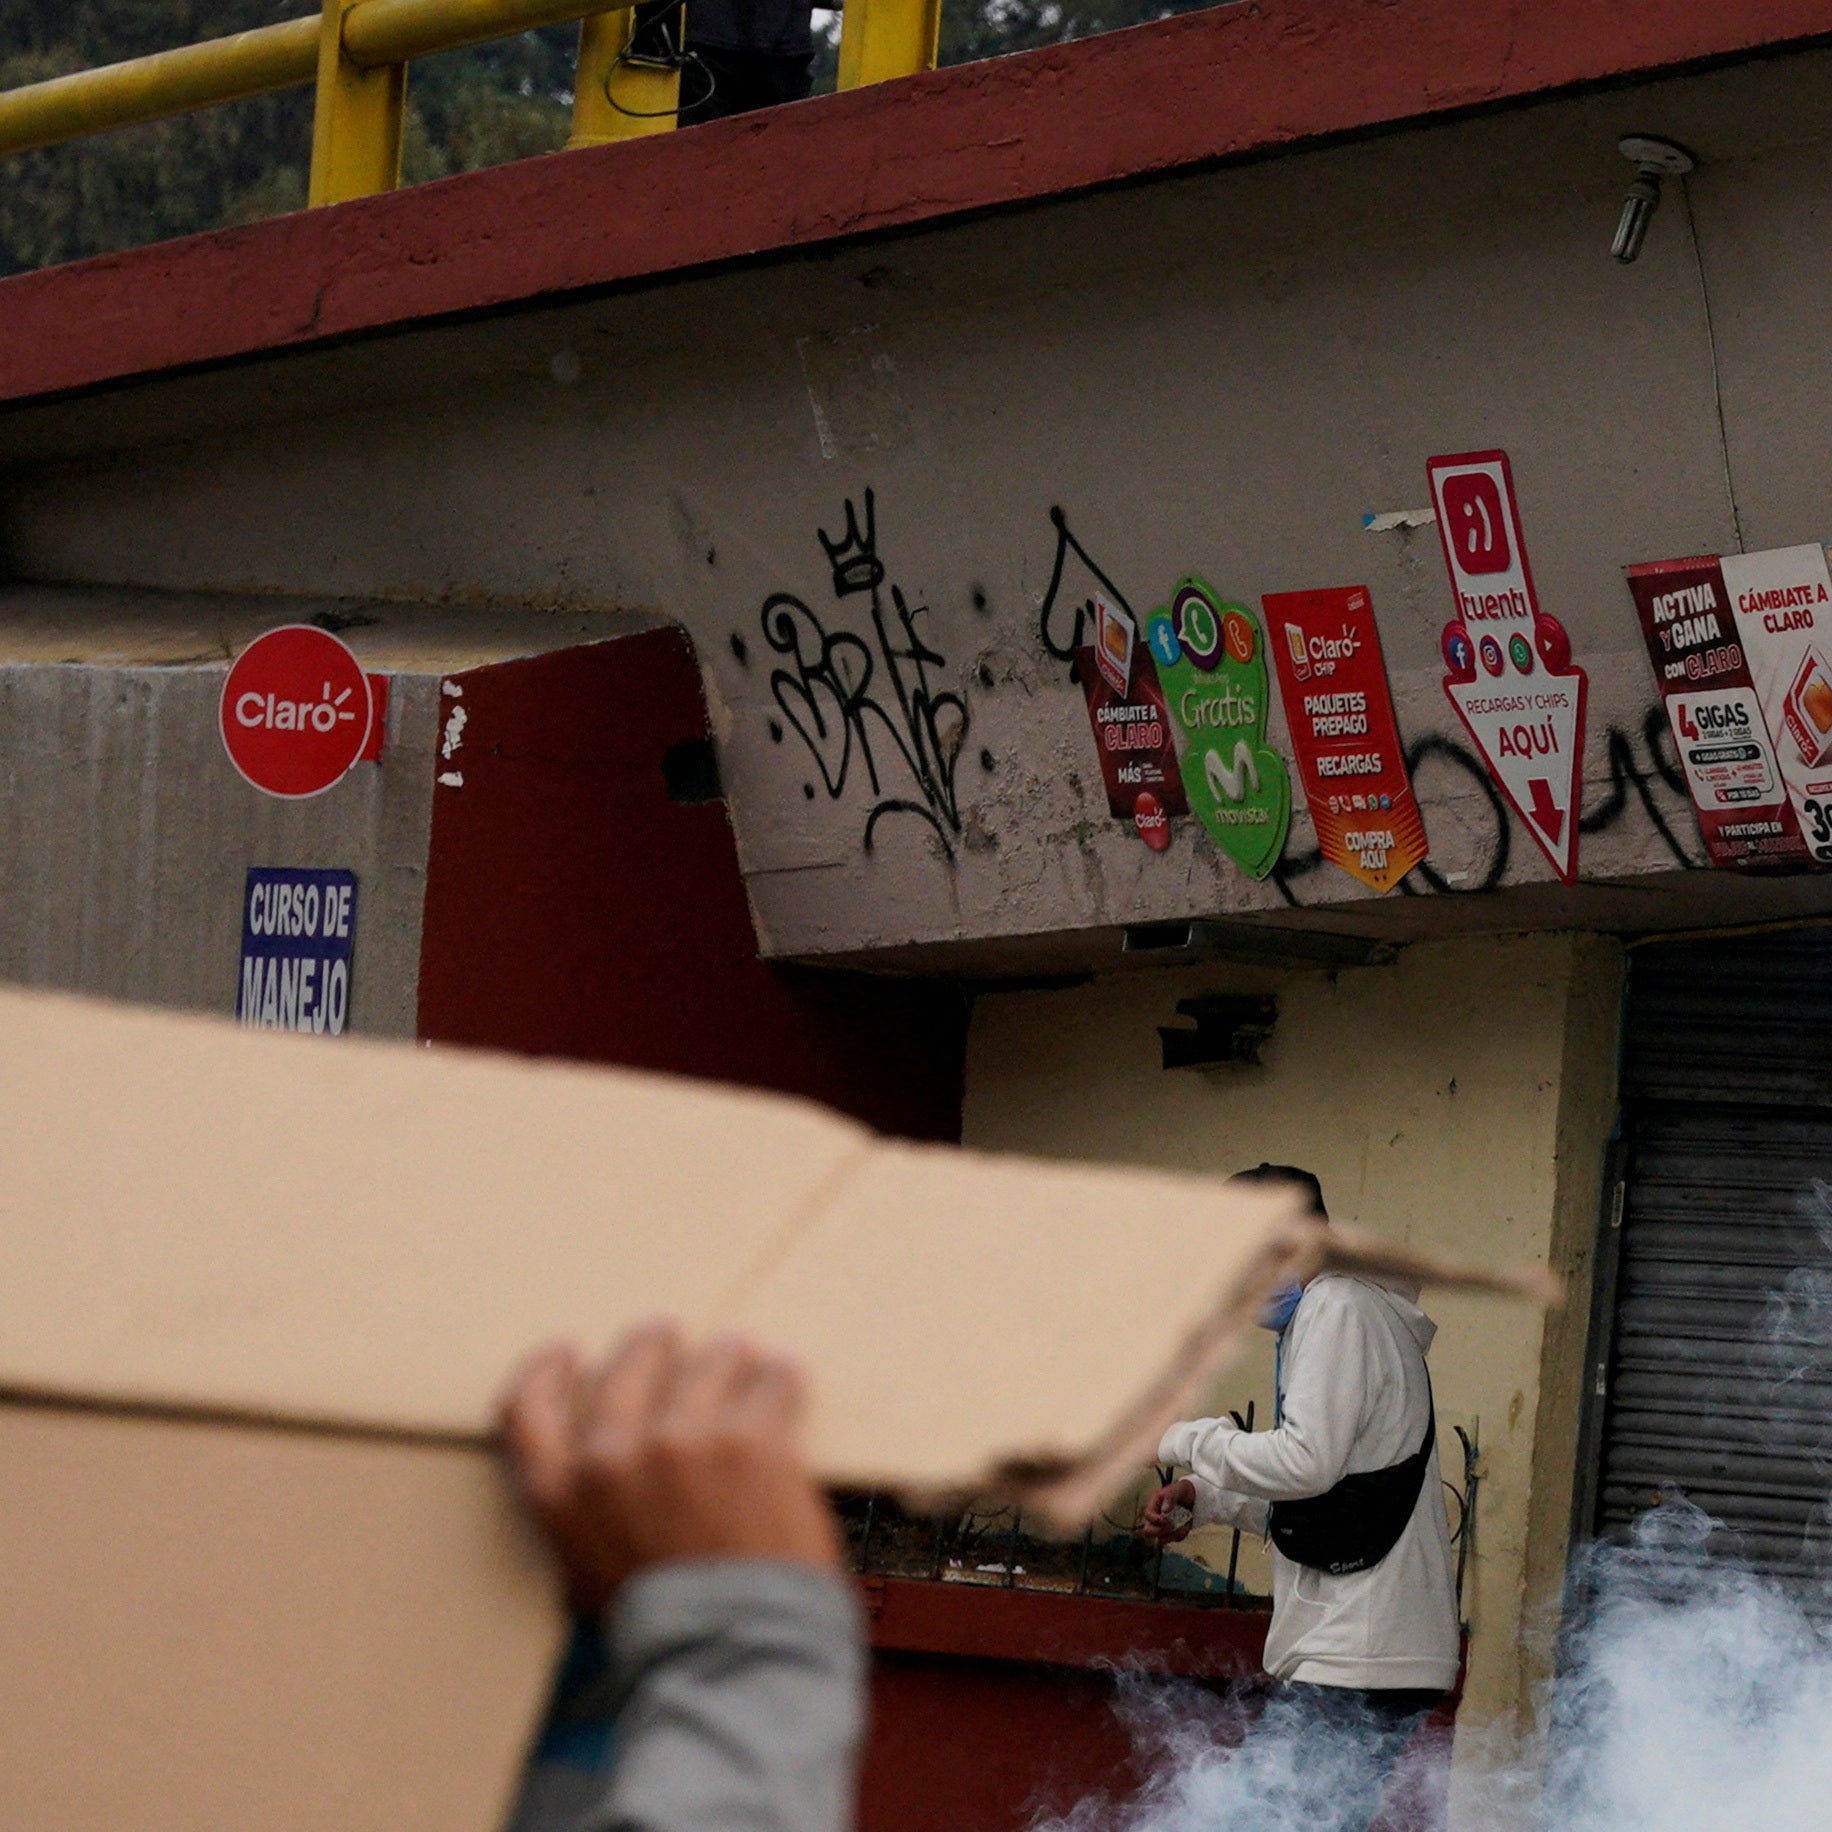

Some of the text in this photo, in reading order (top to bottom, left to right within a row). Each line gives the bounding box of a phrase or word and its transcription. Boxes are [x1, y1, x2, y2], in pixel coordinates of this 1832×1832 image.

[1460, 587, 1529, 621] tuenti
[1652, 582, 1717, 624] ACTIVA
[1738, 583, 1829, 614] CÁMBIATE A
[1660, 613, 1721, 652] Y GANA
[1763, 608, 1814, 634] CLARO
[1308, 632, 1355, 662] Claro
[1664, 643, 1741, 681] CON CLARO
[1314, 663, 1336, 677] CHIP
[236, 690, 340, 733] Claro
[1097, 701, 1158, 722] CÁMBIATE A
[1181, 684, 1257, 729] Gratis
[1304, 692, 1367, 716] PAQUETES
[1466, 692, 1569, 715] RECARGAS Y CHIPS
[1104, 722, 1163, 751] CLARO
[1312, 714, 1368, 737] PREPAGO
[1678, 702, 1750, 741] 4 GIGAS
[1499, 715, 1560, 760] AQUÍ
[1118, 760, 1142, 784] MÁS
[1316, 753, 1382, 776] RECARGAS
[1135, 809, 1164, 829] Claro
[1726, 822, 1771, 837] PARTICIPA
[1804, 798, 1831, 842] 3
[1345, 831, 1395, 851] COMPRA
[250, 882, 352, 938] CURSO DE
[241, 956, 347, 1036] MANEJO
